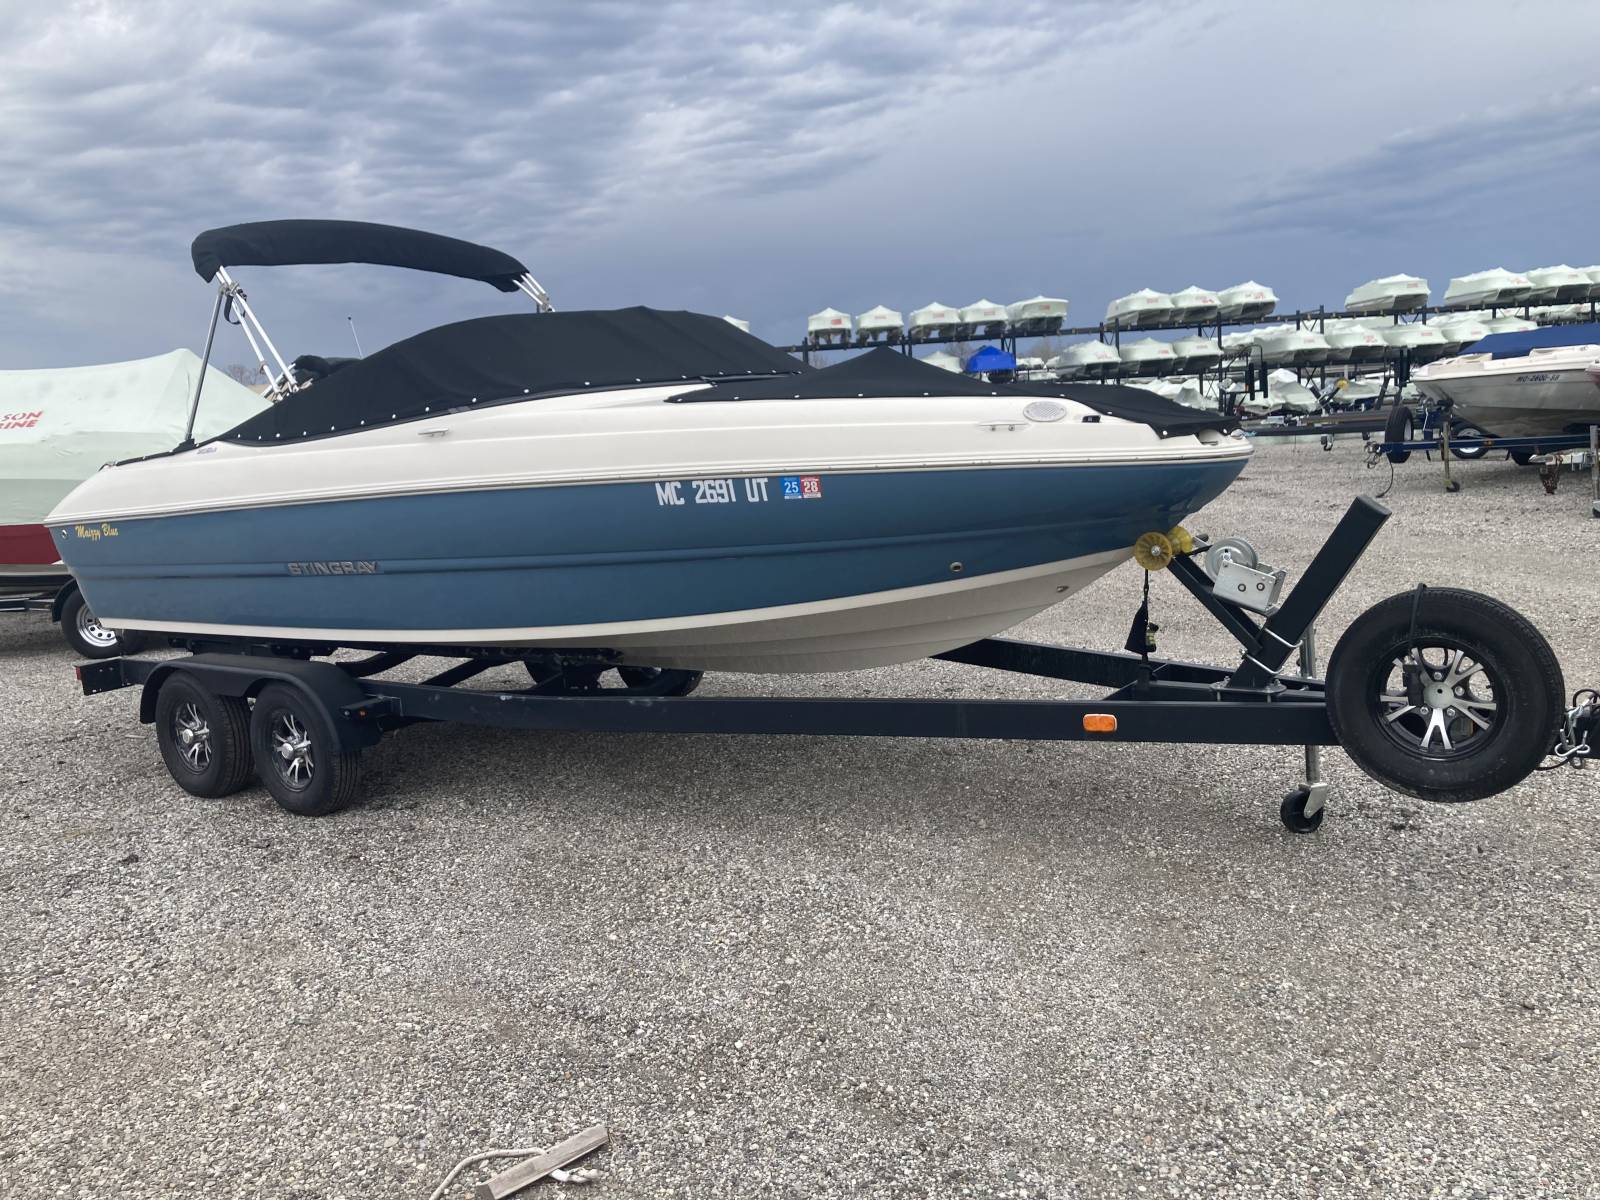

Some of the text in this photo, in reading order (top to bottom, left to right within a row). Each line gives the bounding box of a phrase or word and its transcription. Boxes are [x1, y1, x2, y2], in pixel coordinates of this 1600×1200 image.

[655, 477, 769, 506] MC 2691 UT
[784, 481, 799, 493] 25
[803, 481, 819, 493] 28
[102, 523, 119, 536] Blue
[287, 561, 377, 576] STINGRAY
